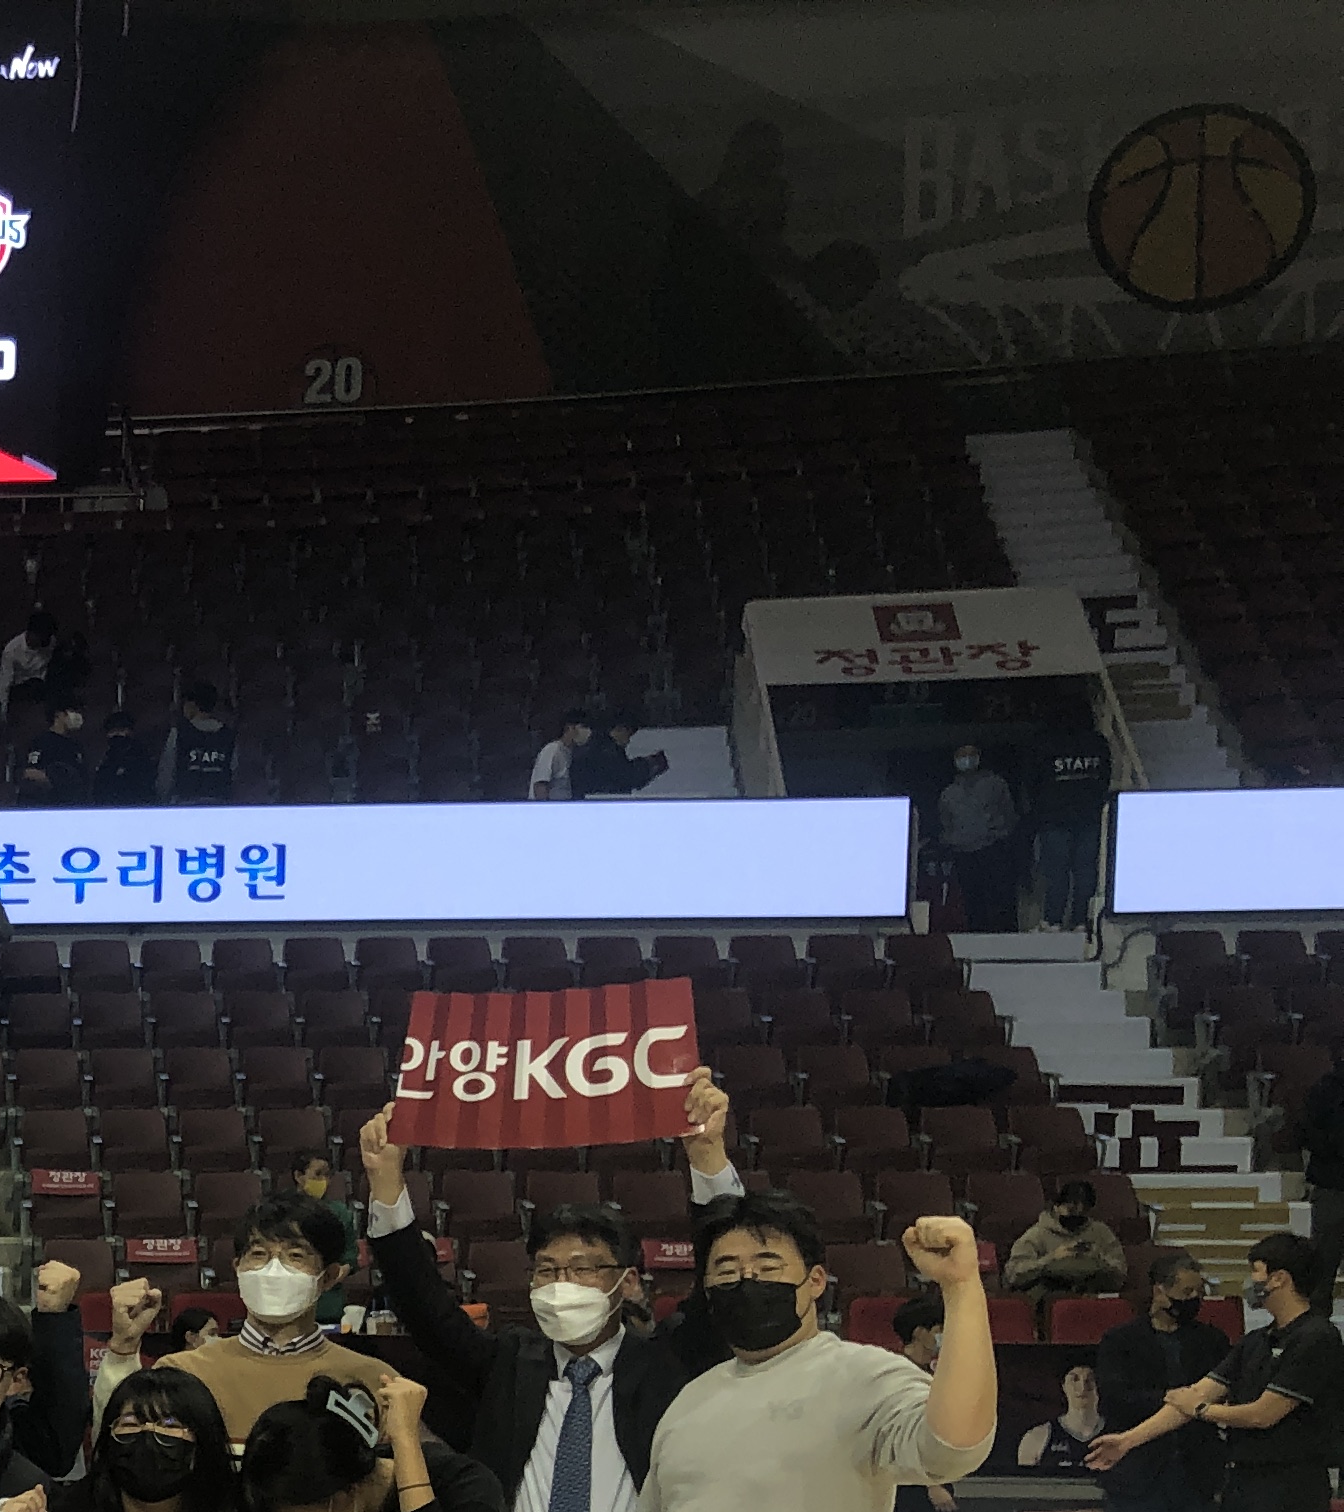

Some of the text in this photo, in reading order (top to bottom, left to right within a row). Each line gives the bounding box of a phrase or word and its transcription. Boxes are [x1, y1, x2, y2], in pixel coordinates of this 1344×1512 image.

[304, 357, 363, 404] 20
[815, 639, 1042, 677] 정관장
[53, 842, 288, 904] 우리병원
